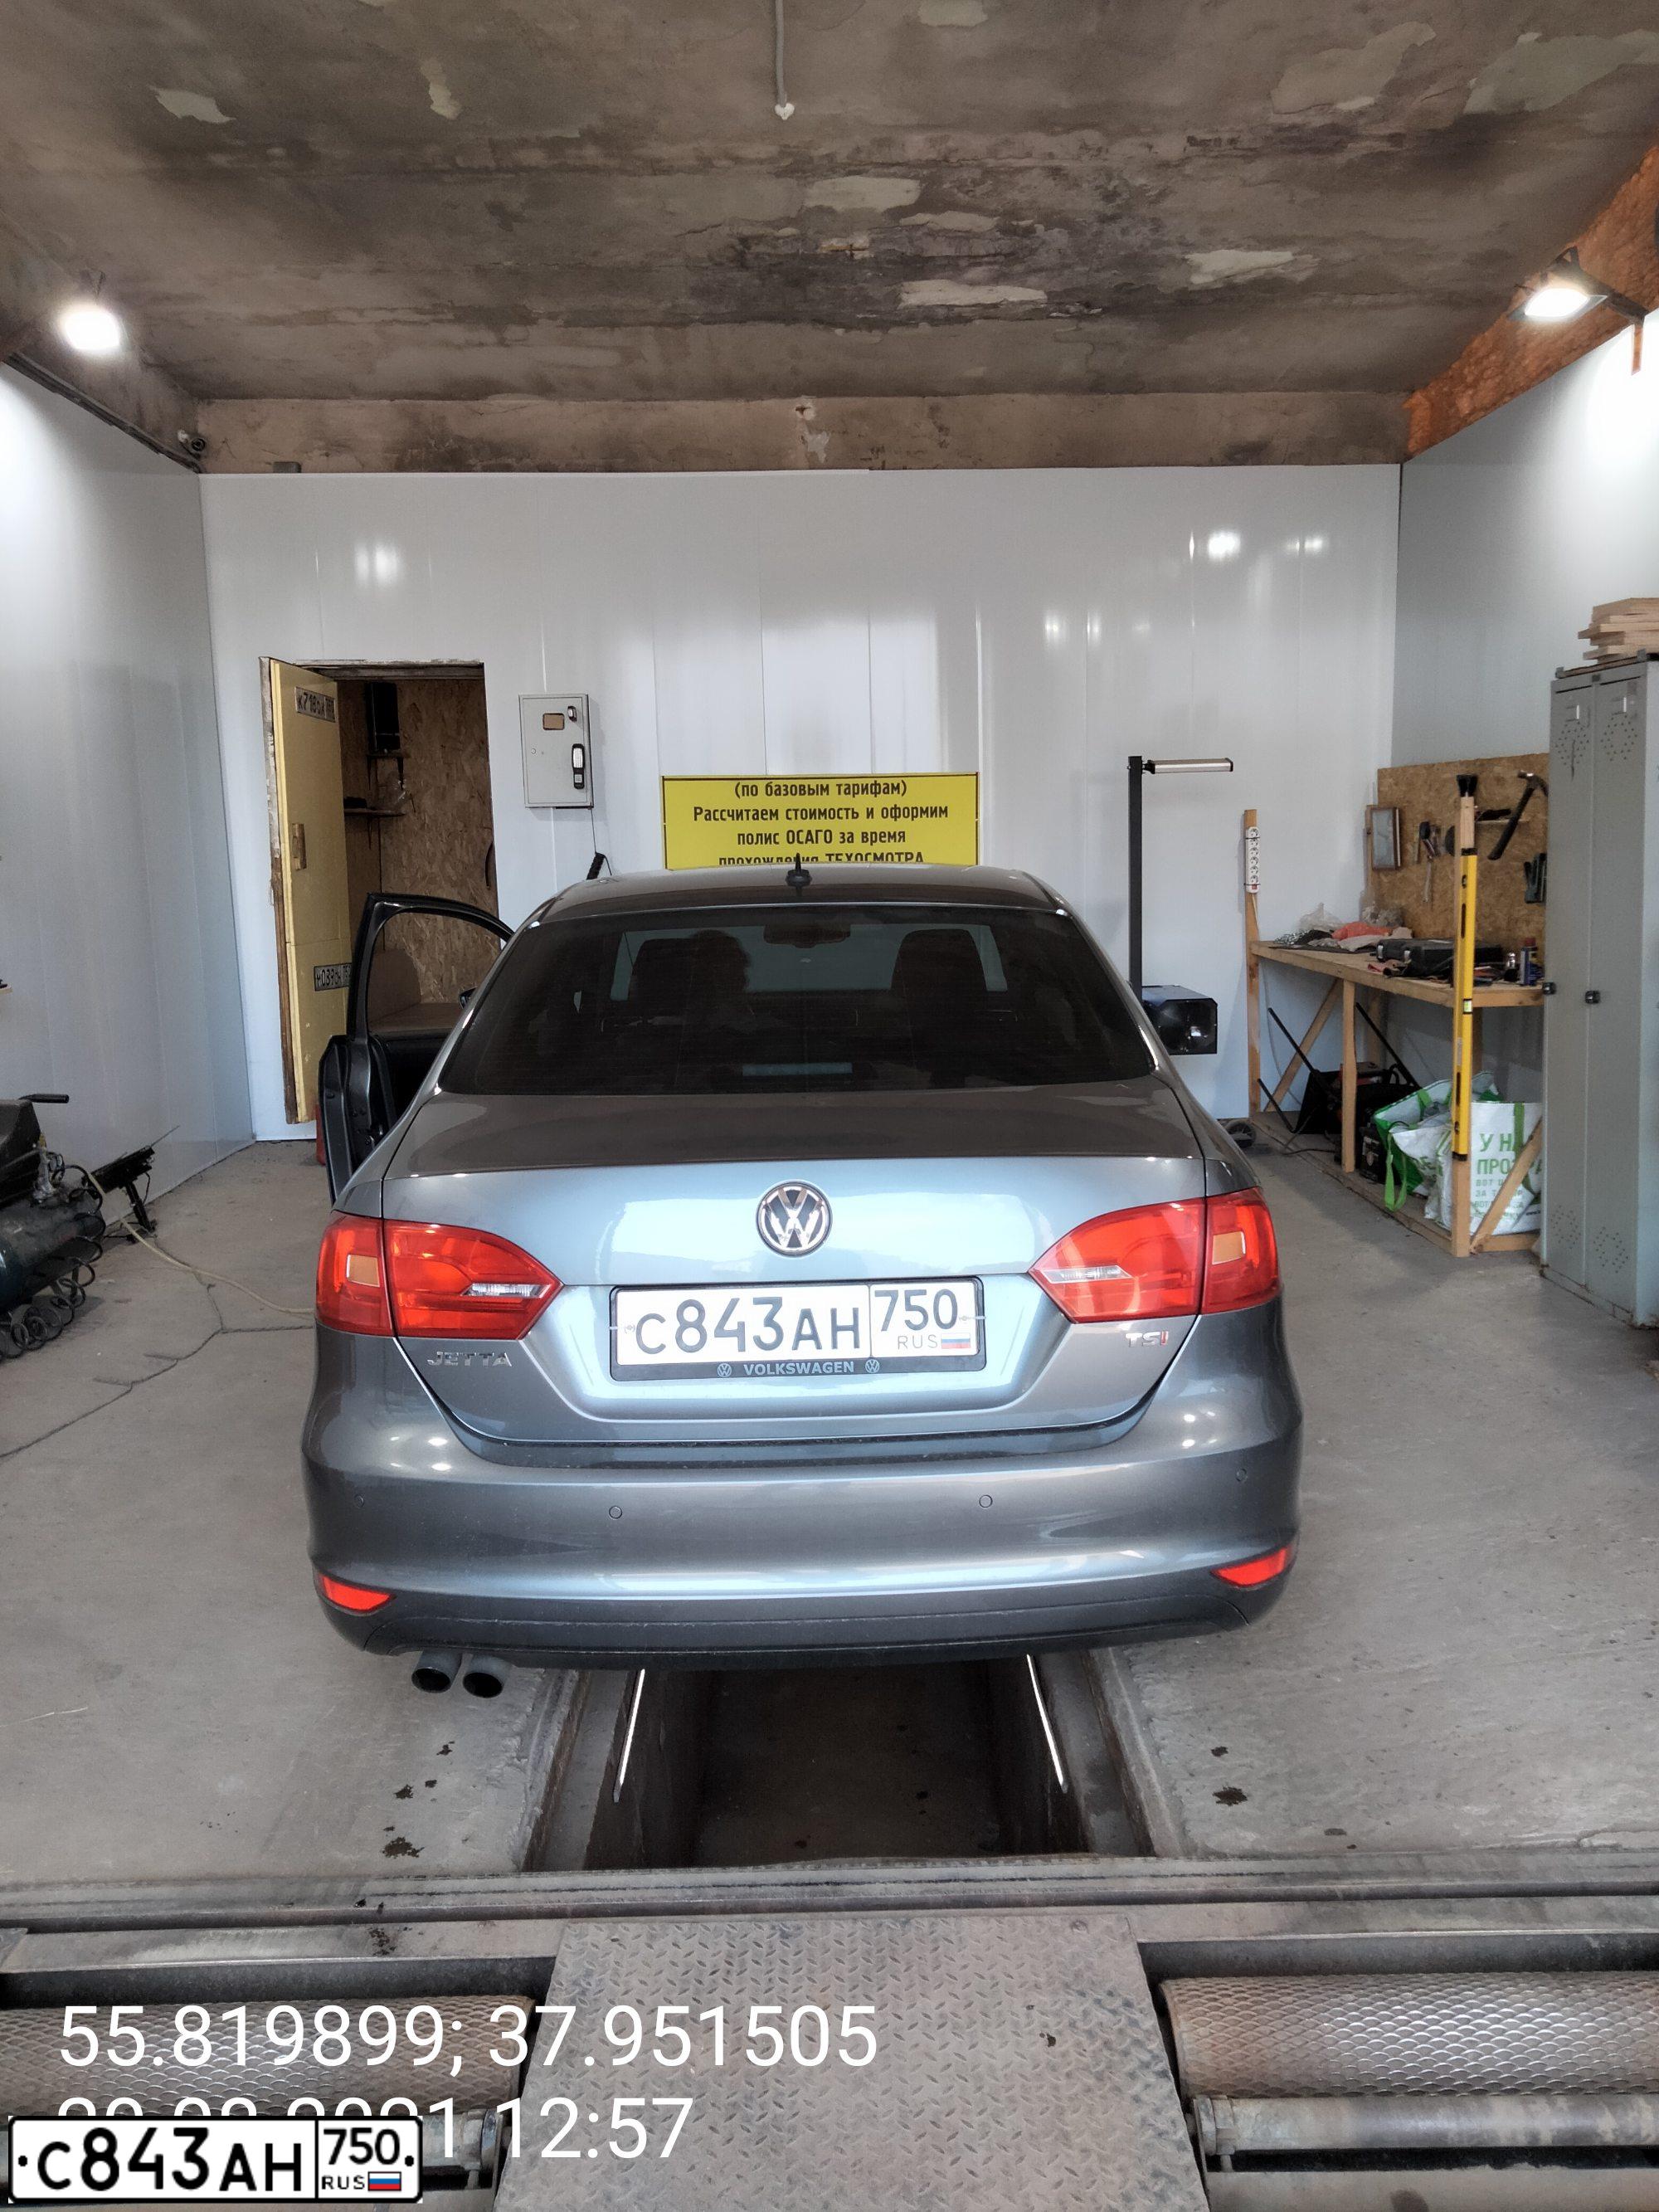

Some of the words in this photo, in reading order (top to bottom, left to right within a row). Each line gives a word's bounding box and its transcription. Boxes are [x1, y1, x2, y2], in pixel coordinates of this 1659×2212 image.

[733, 782, 758, 799] (по
[765, 781, 830, 797] базовым
[836, 780, 907, 797] тарифам)
[693, 806, 779, 822] Рассчитаем
[785, 806, 859, 821] стоимость
[866, 807, 874, 819] и
[881, 804, 948, 821] оформим
[737, 831, 780, 845] полис
[786, 829, 833, 845] ОСАГО
[839, 831, 854, 844] за
[861, 830, 906, 846] время
[825, 851, 924, 864] ТЕХОСМОТРА
[1480, 1133, 1494, 1152] У
[874, 1289, 958, 1332] 750
[897, 1333, 938, 1350] RUS
[1125, 1330, 1169, 1347] TSI
[426, 1351, 513, 1367] JETTA
[743, 1361, 854, 1376] VOLKSWAGEN
